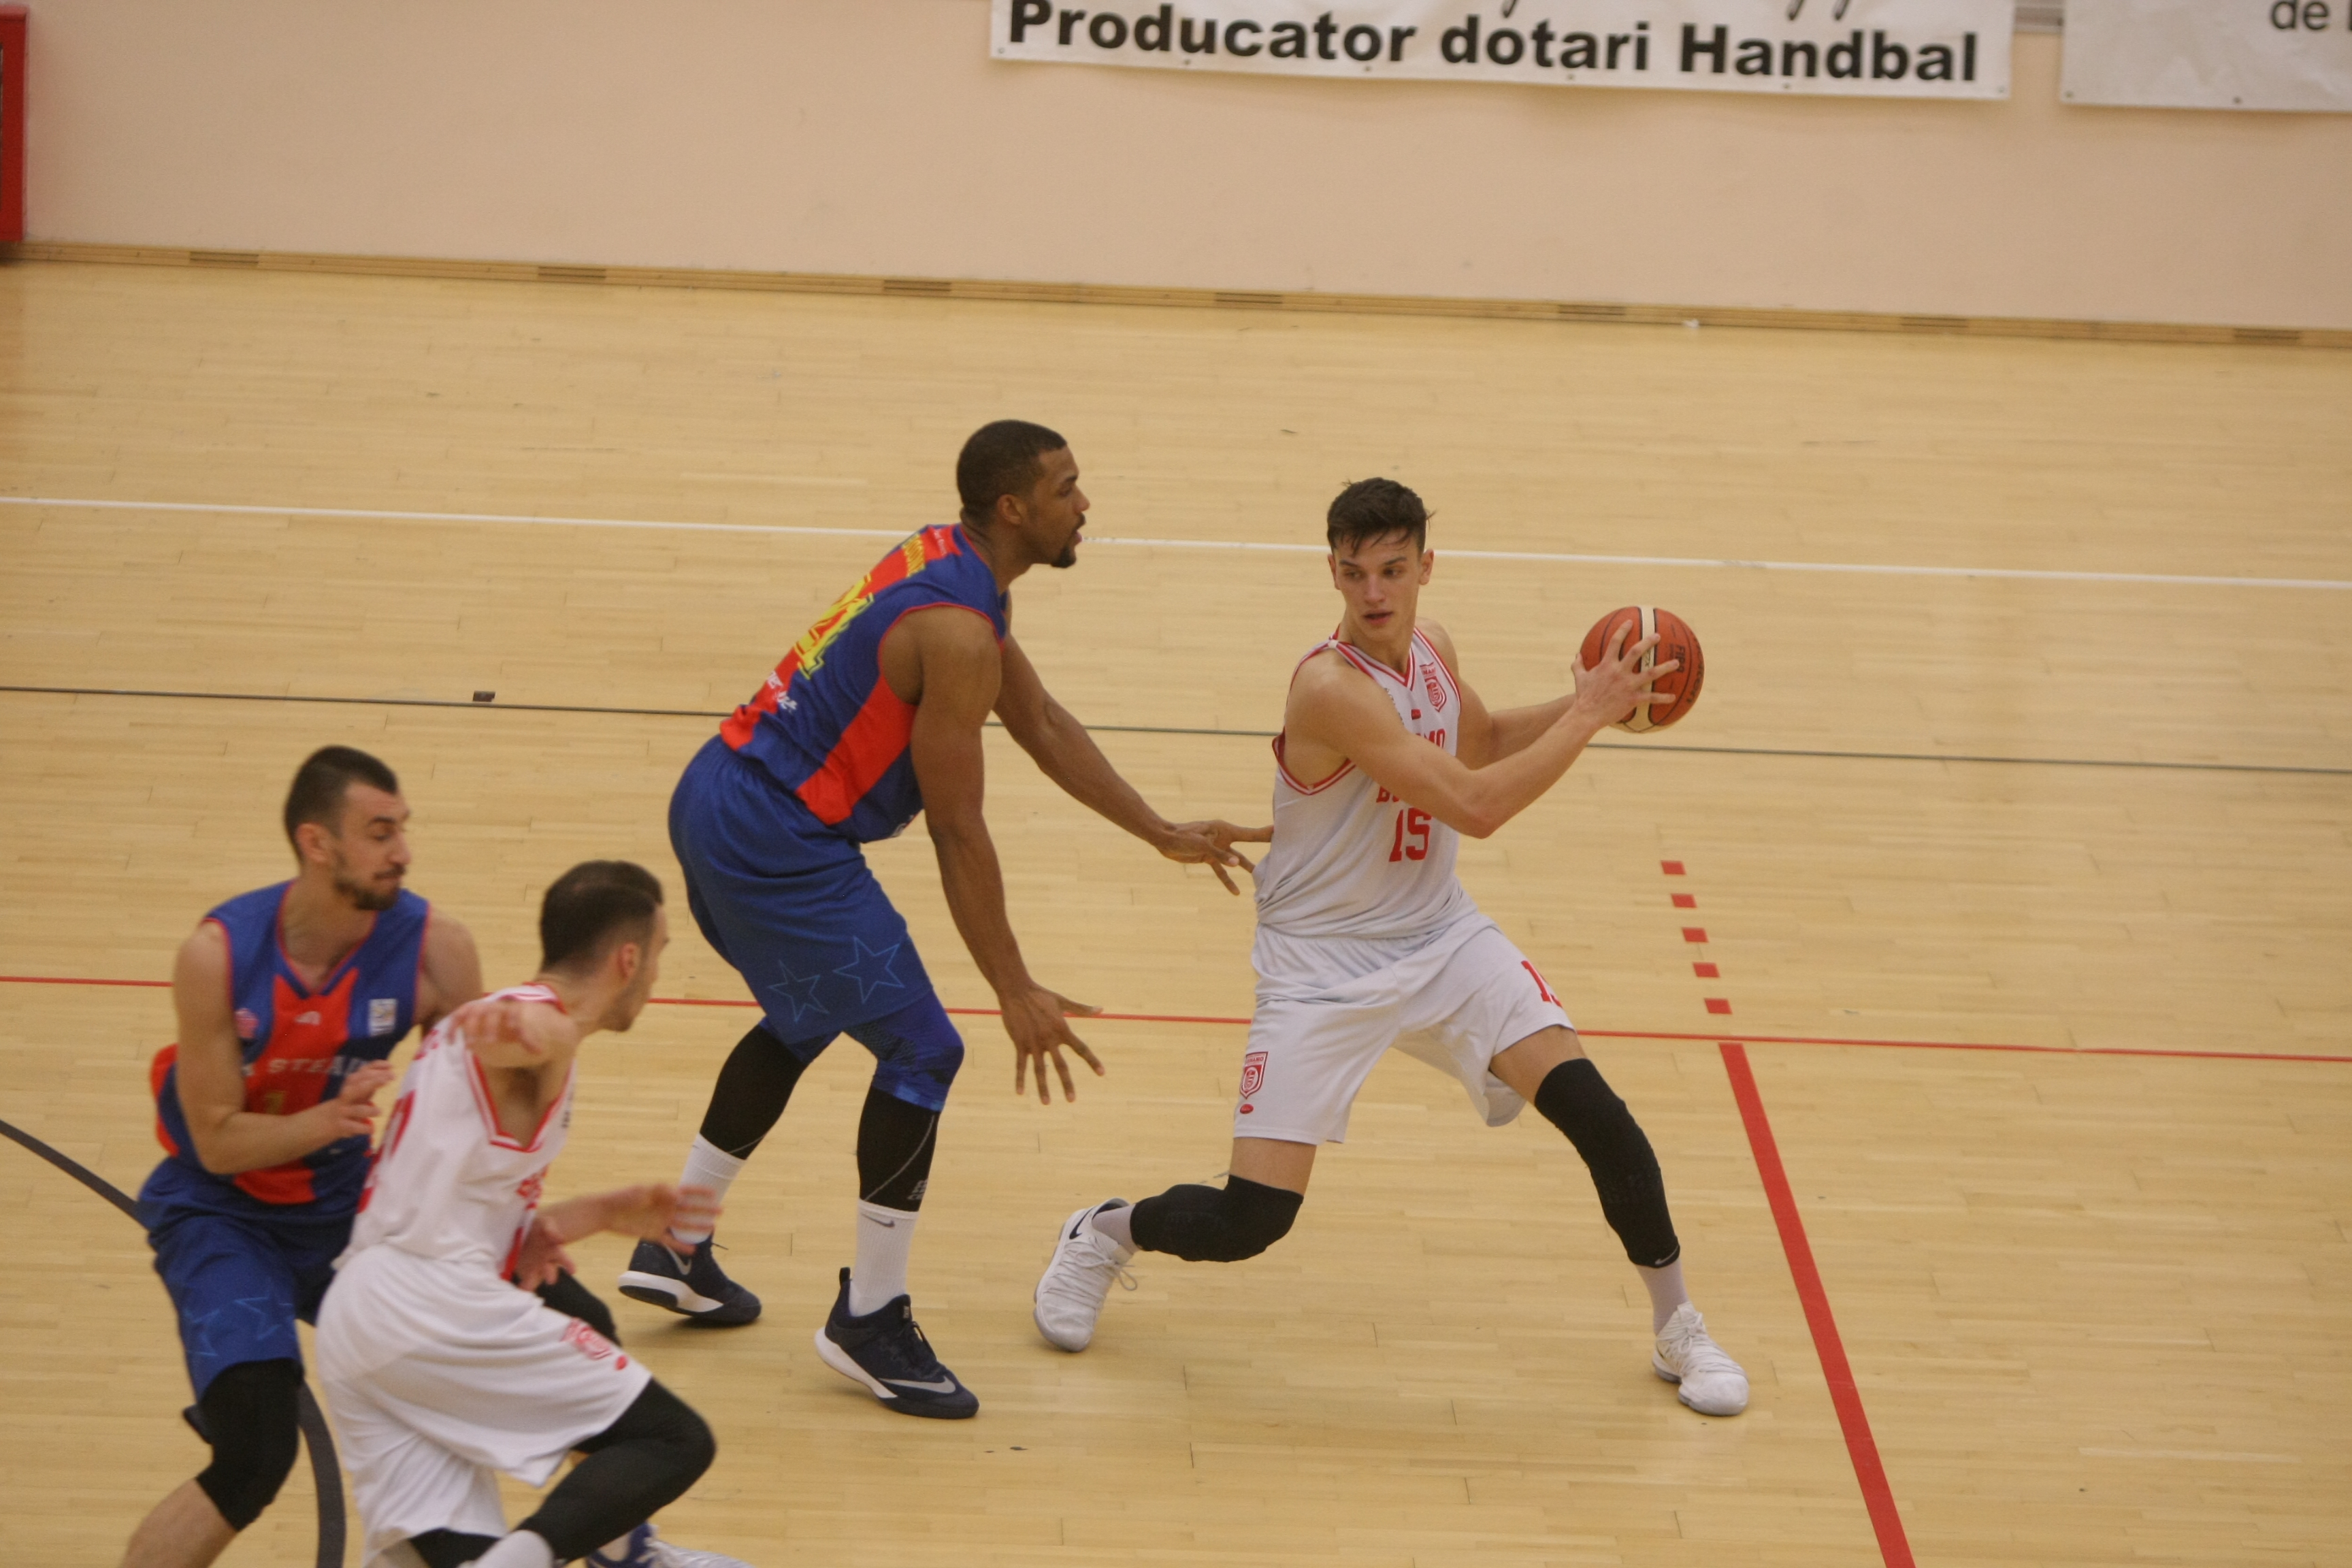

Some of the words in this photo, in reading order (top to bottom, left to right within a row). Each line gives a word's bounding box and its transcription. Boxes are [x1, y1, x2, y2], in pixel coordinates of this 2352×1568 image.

[1010, 0, 1416, 62] Producator
[1440, 15, 1649, 71] dotari
[1680, 24, 1976, 82] Handbal
[2270, 0, 2330, 32] de
[1388, 807, 1433, 862] 15
